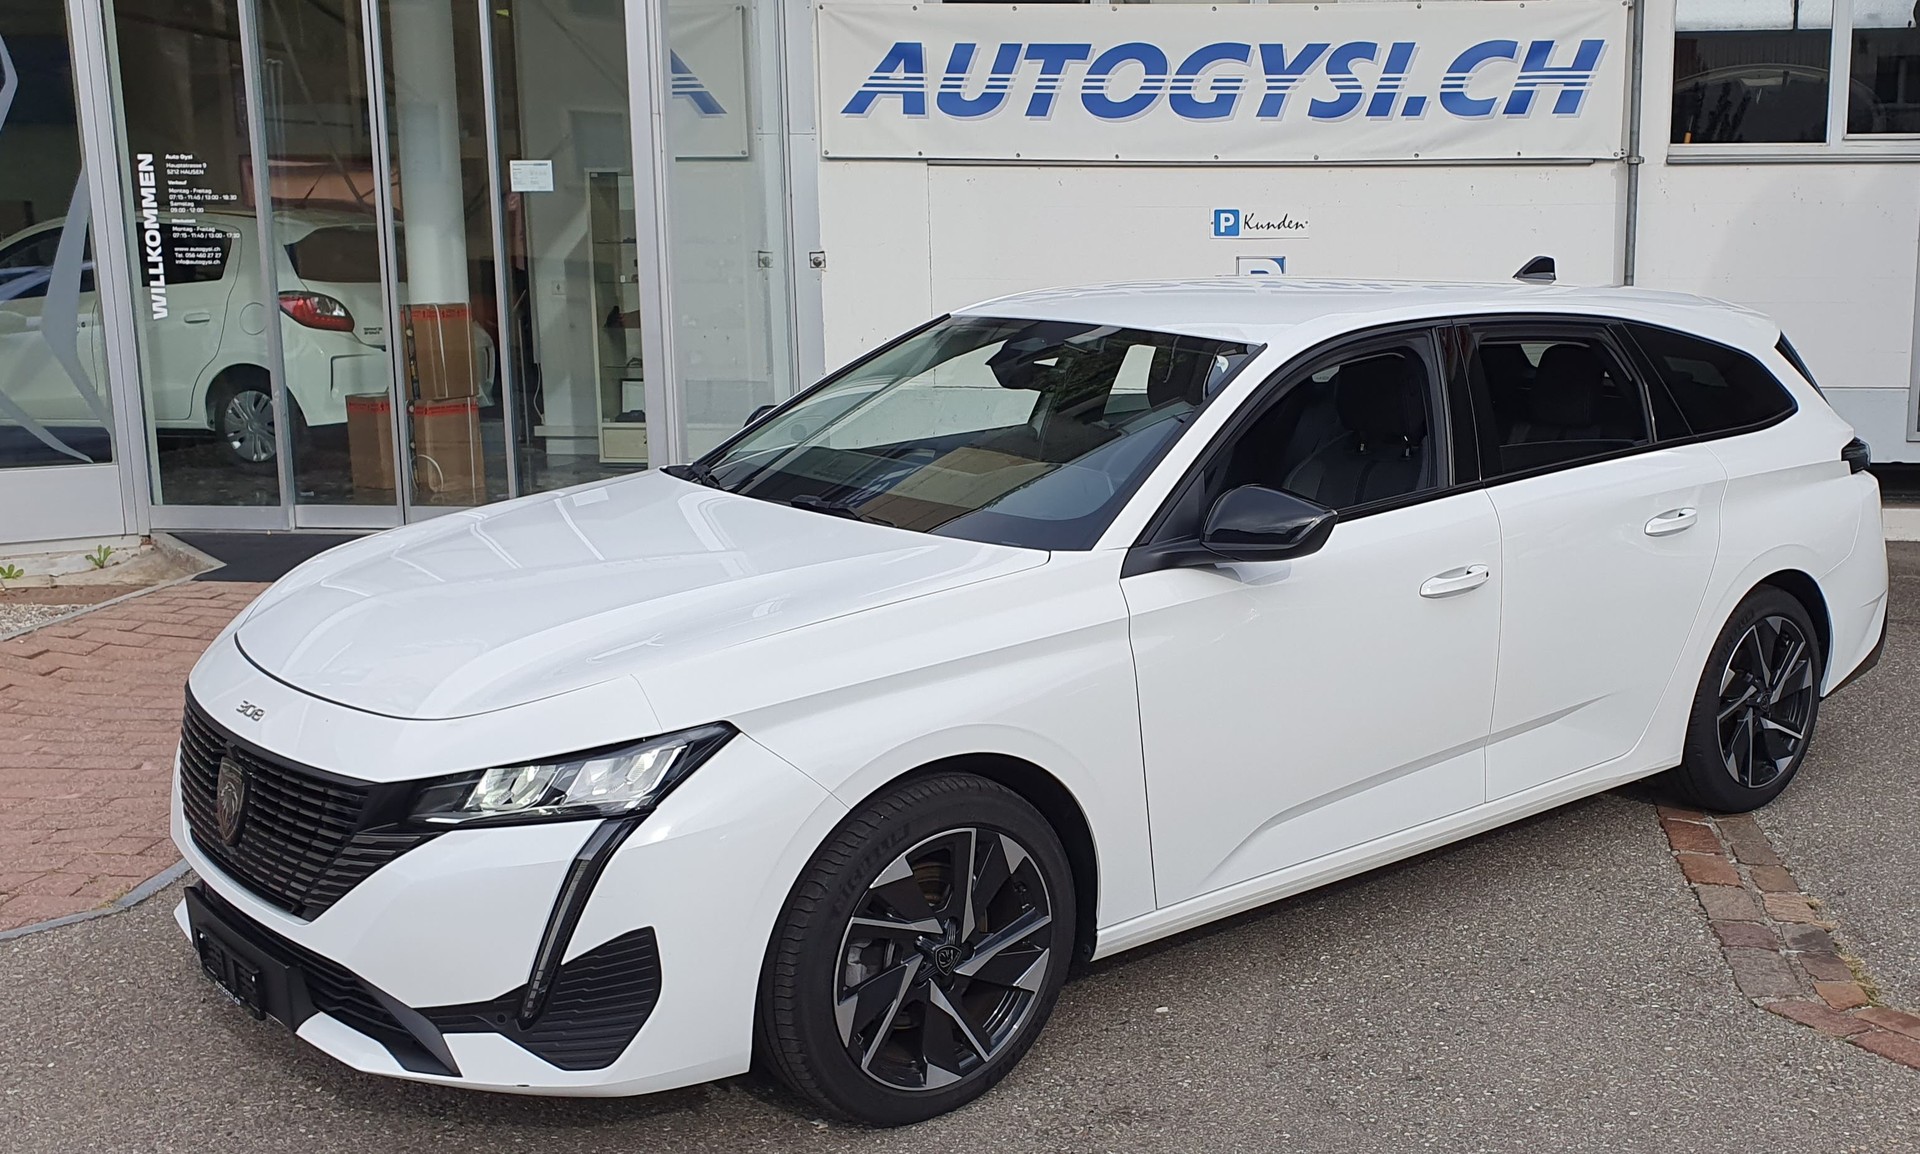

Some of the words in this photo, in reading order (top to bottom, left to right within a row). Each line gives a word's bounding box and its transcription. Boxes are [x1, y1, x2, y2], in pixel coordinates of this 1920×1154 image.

[840, 39, 1607, 119] AUTOGYSI.CH
[137, 153, 168, 320] WILLKOMMEN
[1220, 212, 1235, 233] P
[1243, 212, 1305, 230] Kunden
[236, 700, 265, 721] 308
